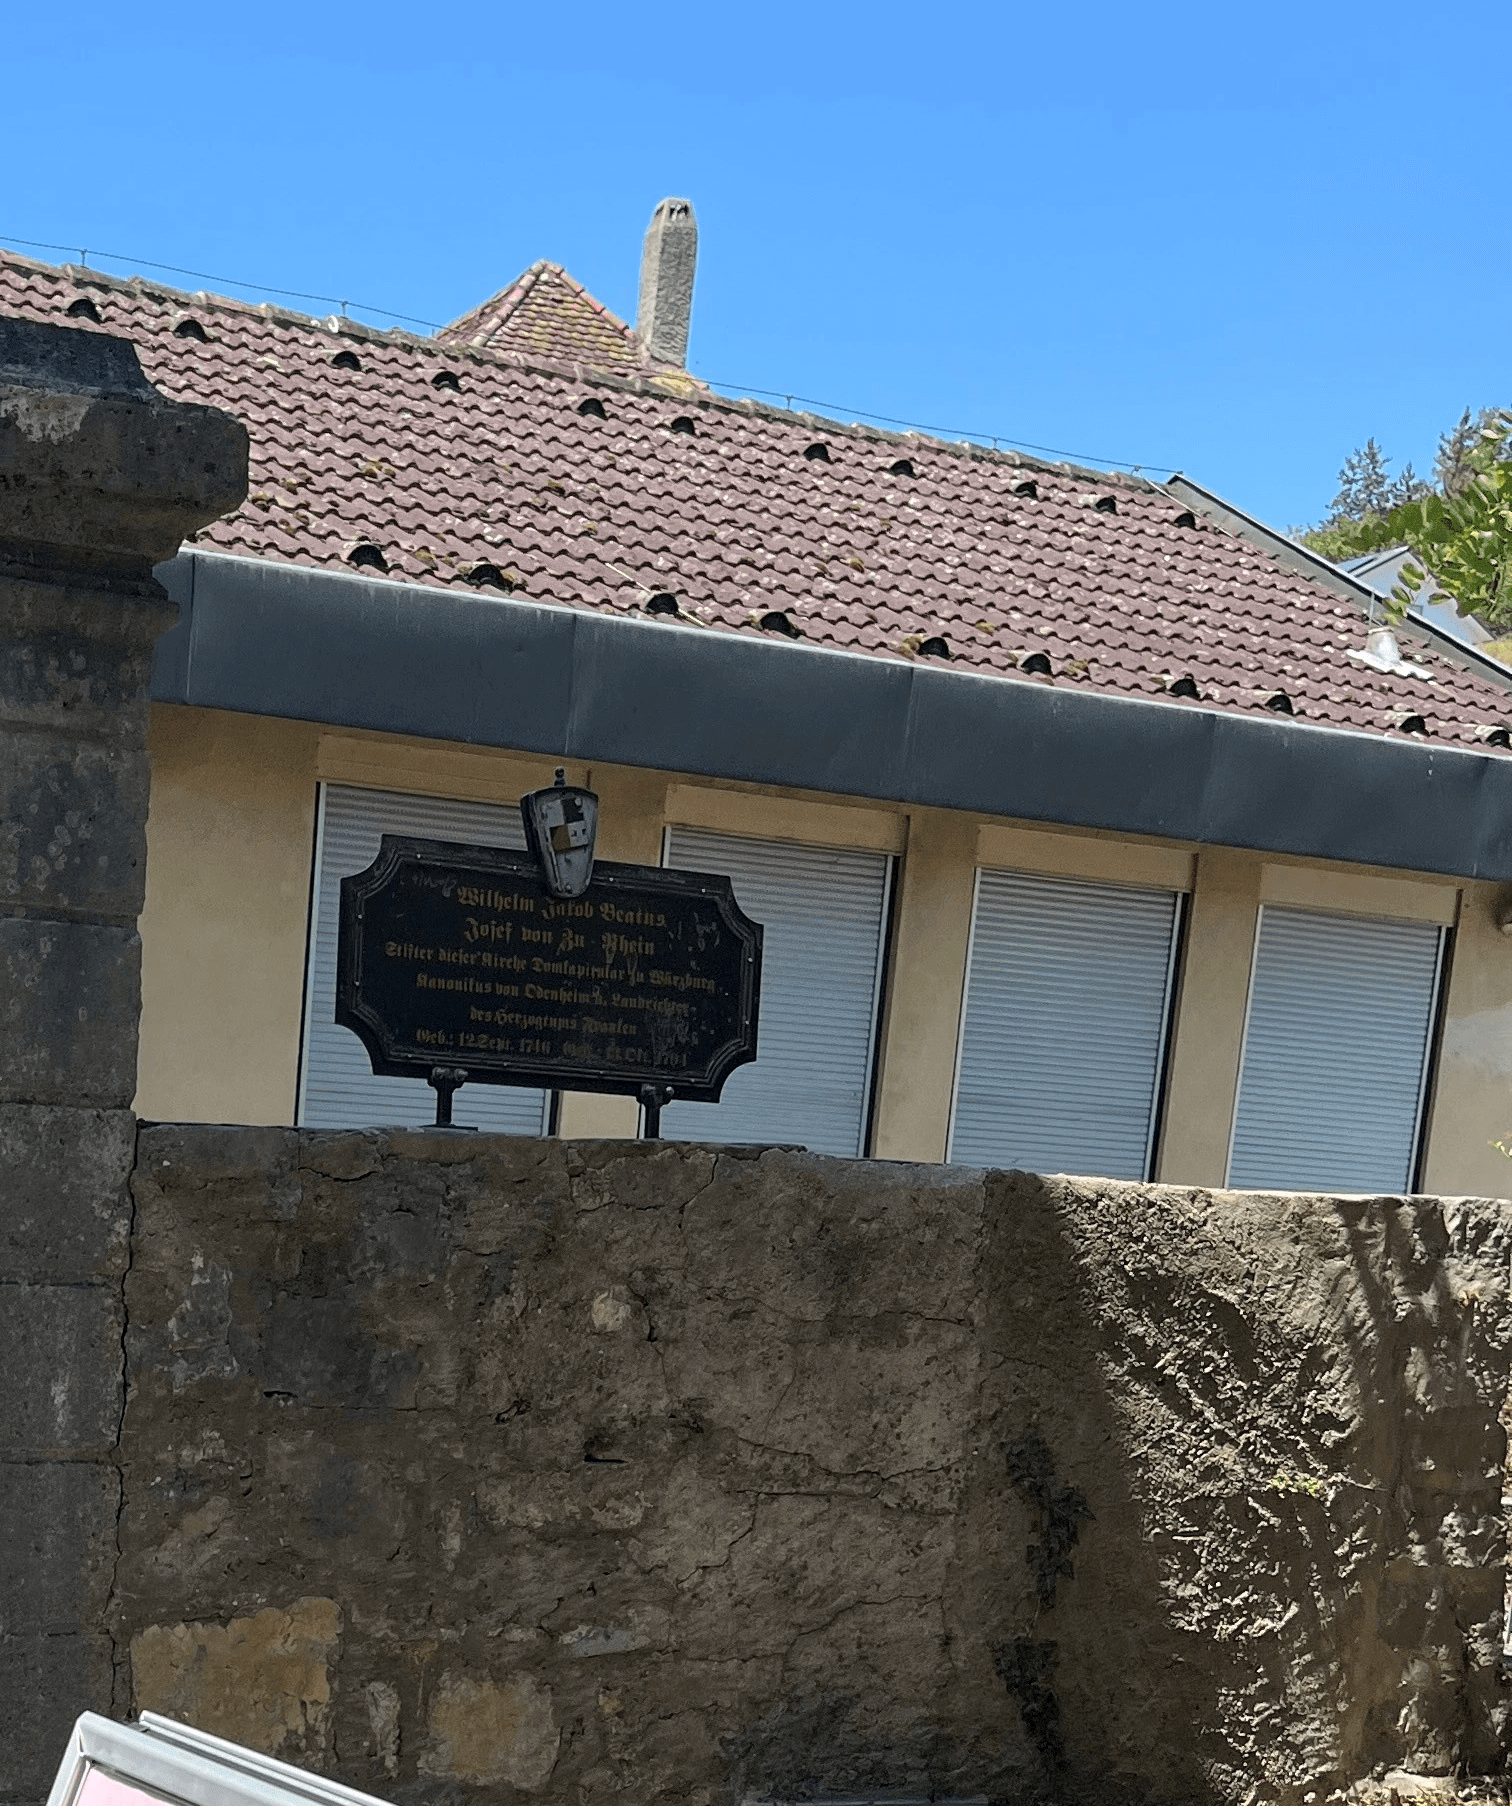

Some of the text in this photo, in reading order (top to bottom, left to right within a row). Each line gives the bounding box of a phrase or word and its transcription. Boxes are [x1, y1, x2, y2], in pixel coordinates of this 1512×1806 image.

[457, 886, 534, 912] Wilhelm
[463, 917, 513, 946] Josef
[521, 926, 554, 944] von
[495, 981, 519, 997] von
